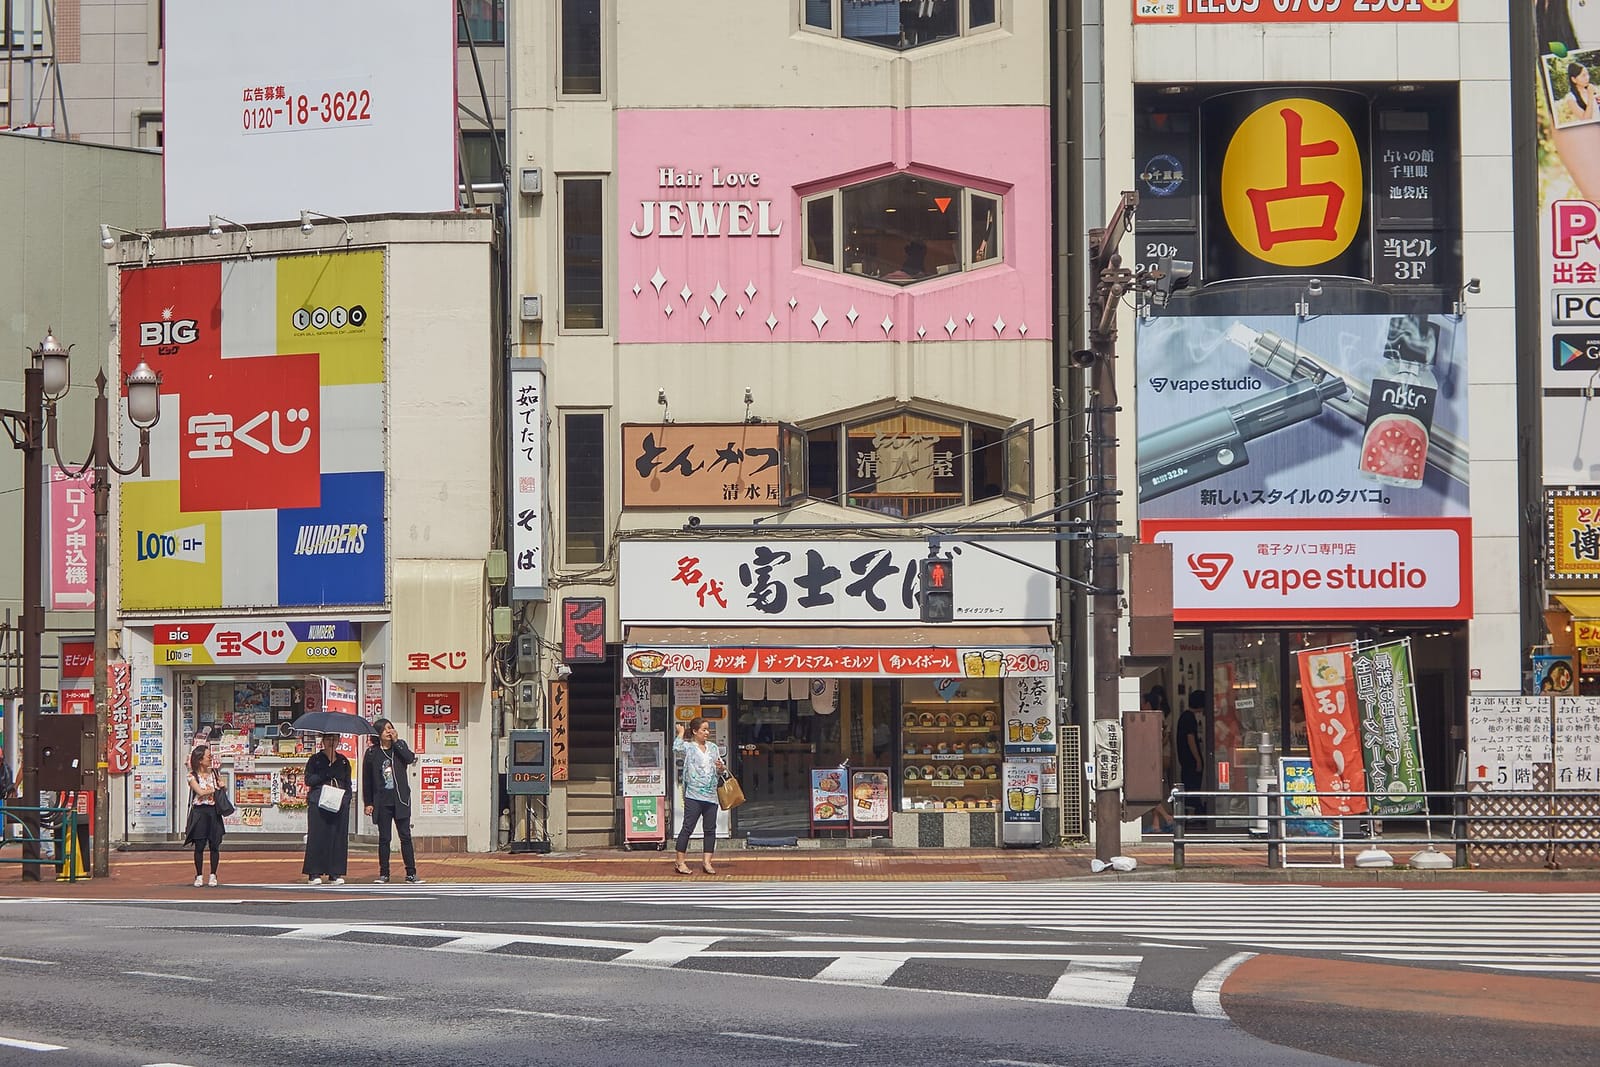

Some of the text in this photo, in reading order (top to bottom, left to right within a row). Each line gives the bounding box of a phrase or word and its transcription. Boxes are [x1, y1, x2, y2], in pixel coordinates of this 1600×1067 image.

[242, 86, 286, 102] 広告募集
[242, 89, 372, 130] 0120-18-3622
[1383, 149, 1435, 163] 占いの館
[658, 167, 761, 188] Hair Love
[1246, 108, 1345, 251] 占
[1389, 165, 1429, 178] 千里眼
[1389, 186, 1429, 200] 池袋店
[630, 200, 784, 239] JEWEL
[1146, 243, 1178, 257] 20分
[1383, 238, 1438, 258] 当ビル
[1394, 261, 1427, 279] 3F
[1553, 262, 1598, 284] 出会
[292, 305, 367, 331] toto
[140, 319, 198, 347] BIG
[1170, 377, 1262, 394] vape studio
[516, 385, 539, 462] 茹でたて
[188, 408, 312, 459] 宝くじ
[635, 432, 779, 478] とんかつ
[722, 483, 780, 500] 清水屋
[1201, 488, 1391, 506] 新しいスタイルのタバコ。
[66, 488, 88, 584] ローン申込機
[294, 524, 368, 556] NUMBERS
[516, 509, 540, 571] そば
[137, 530, 176, 561] LOTO
[1257, 543, 1356, 556] 電子タバコ専門店
[671, 555, 728, 609] 名代
[1242, 562, 1427, 595] vape studio
[168, 631, 189, 640] BIG
[308, 624, 336, 640] NUMBERS
[216, 629, 286, 657] 宝くじ
[306, 646, 338, 657] toto
[65, 653, 95, 666] モビット
[166, 649, 182, 661] LOTO
[408, 651, 467, 671] 宝くじ
[662, 654, 704, 672] 490円
[713, 654, 748, 669] カツ丼
[764, 654, 874, 669] ザ・プレミアム・モルツ
[889, 654, 953, 670] 角ハイボール
[1005, 654, 1050, 672] 280円
[365, 703, 382, 715] BIG
[424, 703, 453, 716] BIG
[112, 667, 131, 772] ジャンボ宝くじ
[552, 684, 566, 755] とんかつ
[1497, 766, 1531, 784] 5階
[1560, 767, 1600, 783] 看板
